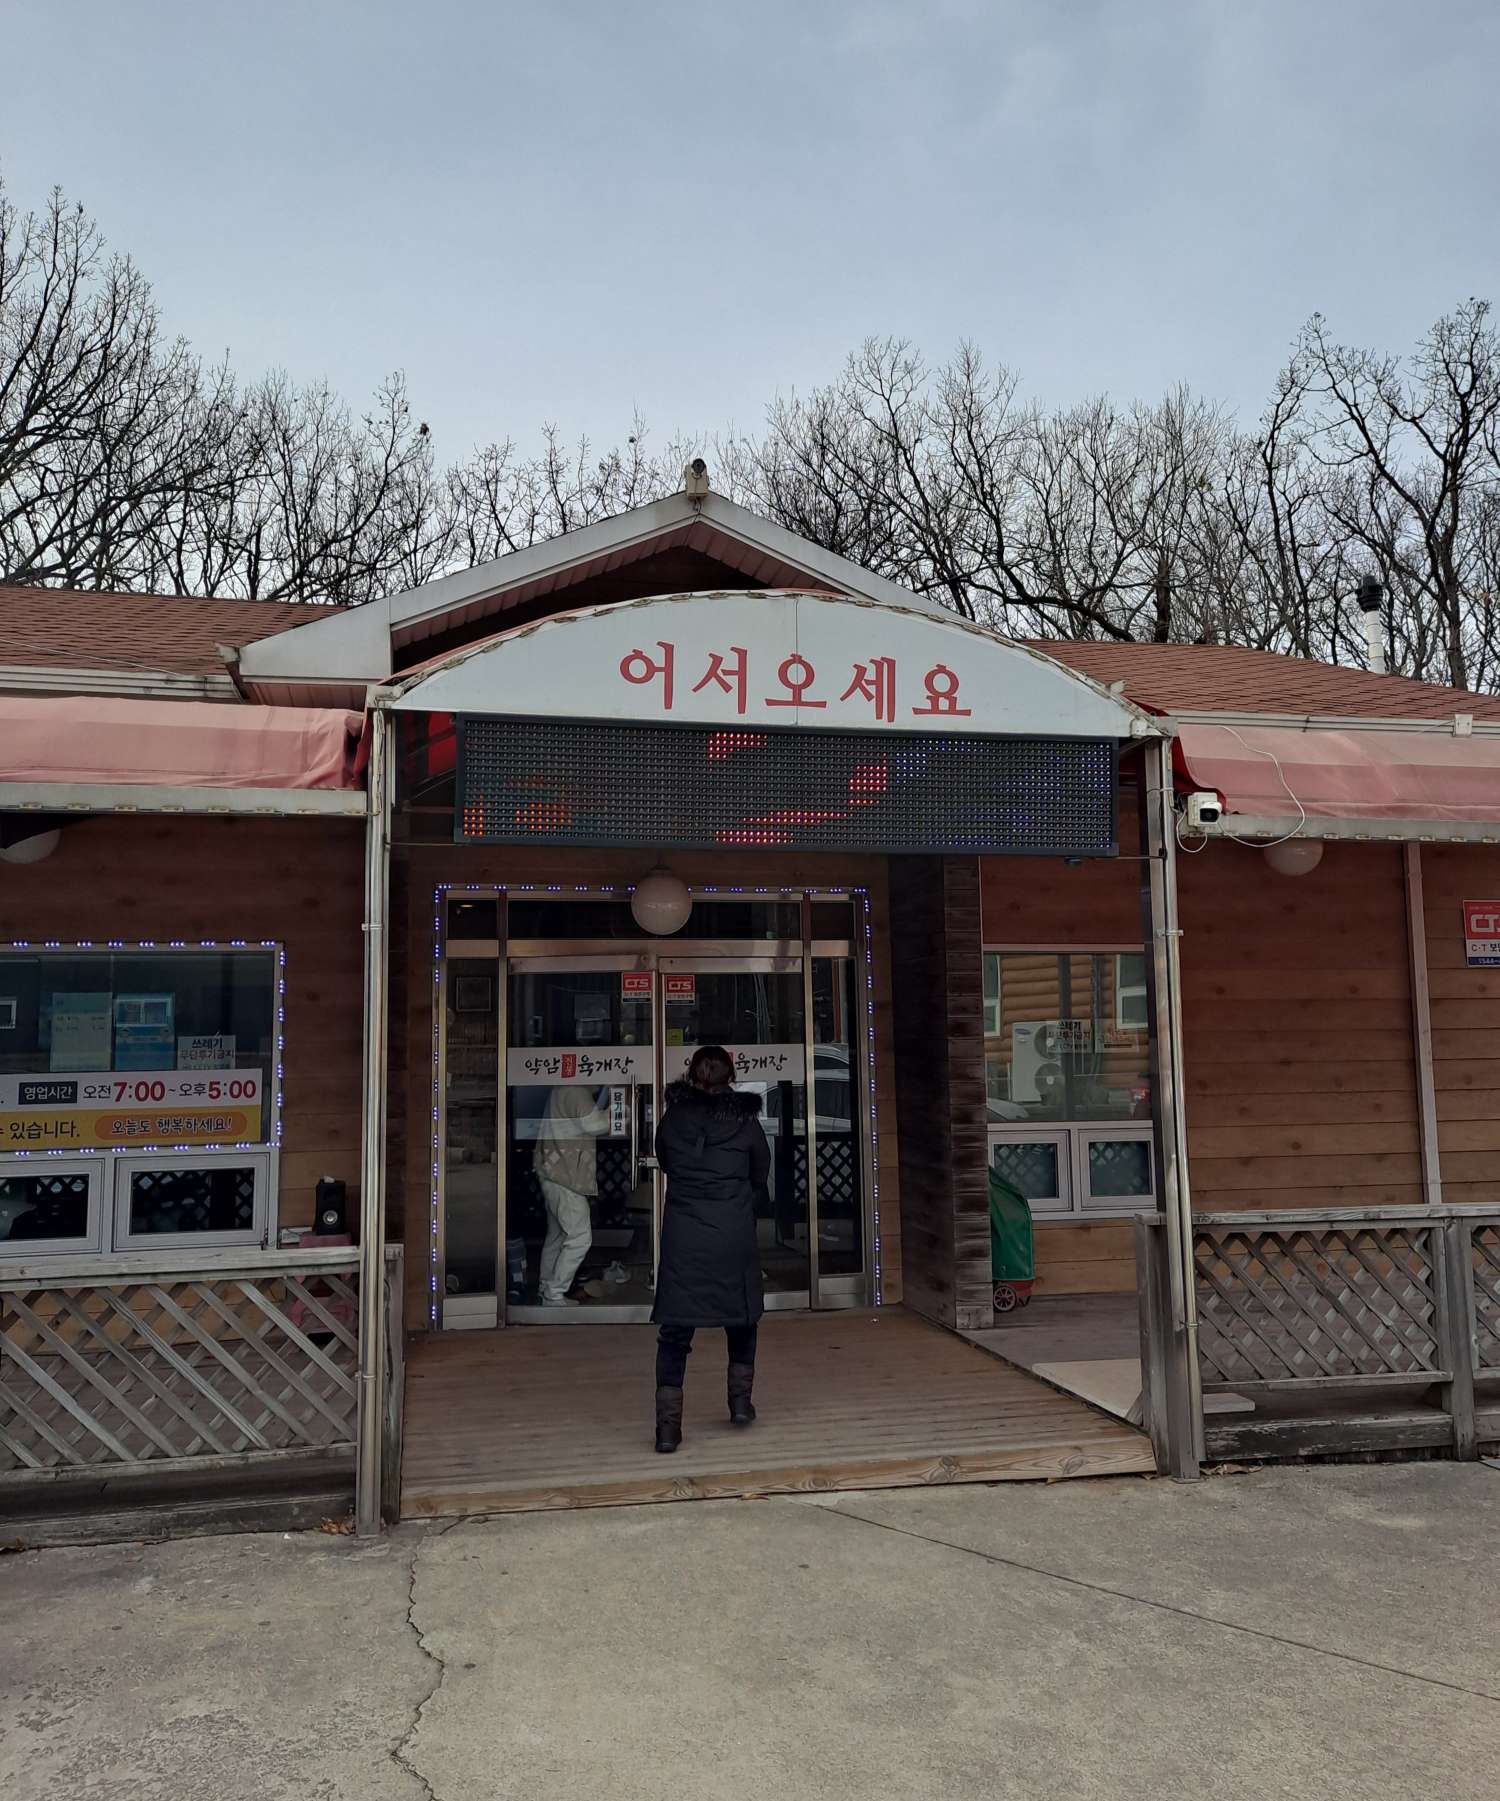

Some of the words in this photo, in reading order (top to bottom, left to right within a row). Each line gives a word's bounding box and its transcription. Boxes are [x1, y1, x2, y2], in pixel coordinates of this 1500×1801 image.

[618, 640, 973, 723] 어서오세요
[191, 1037, 223, 1049] 쓰레기
[578, 1055, 634, 1076] 육개장
[735, 1052, 788, 1074] 육개장
[24, 1085, 73, 1100] 영업시간
[10, 1120, 80, 1140] 있습니다.
[111, 1119, 152, 1135] 오늘도
[157, 1117, 233, 1135] 행복하세요!
